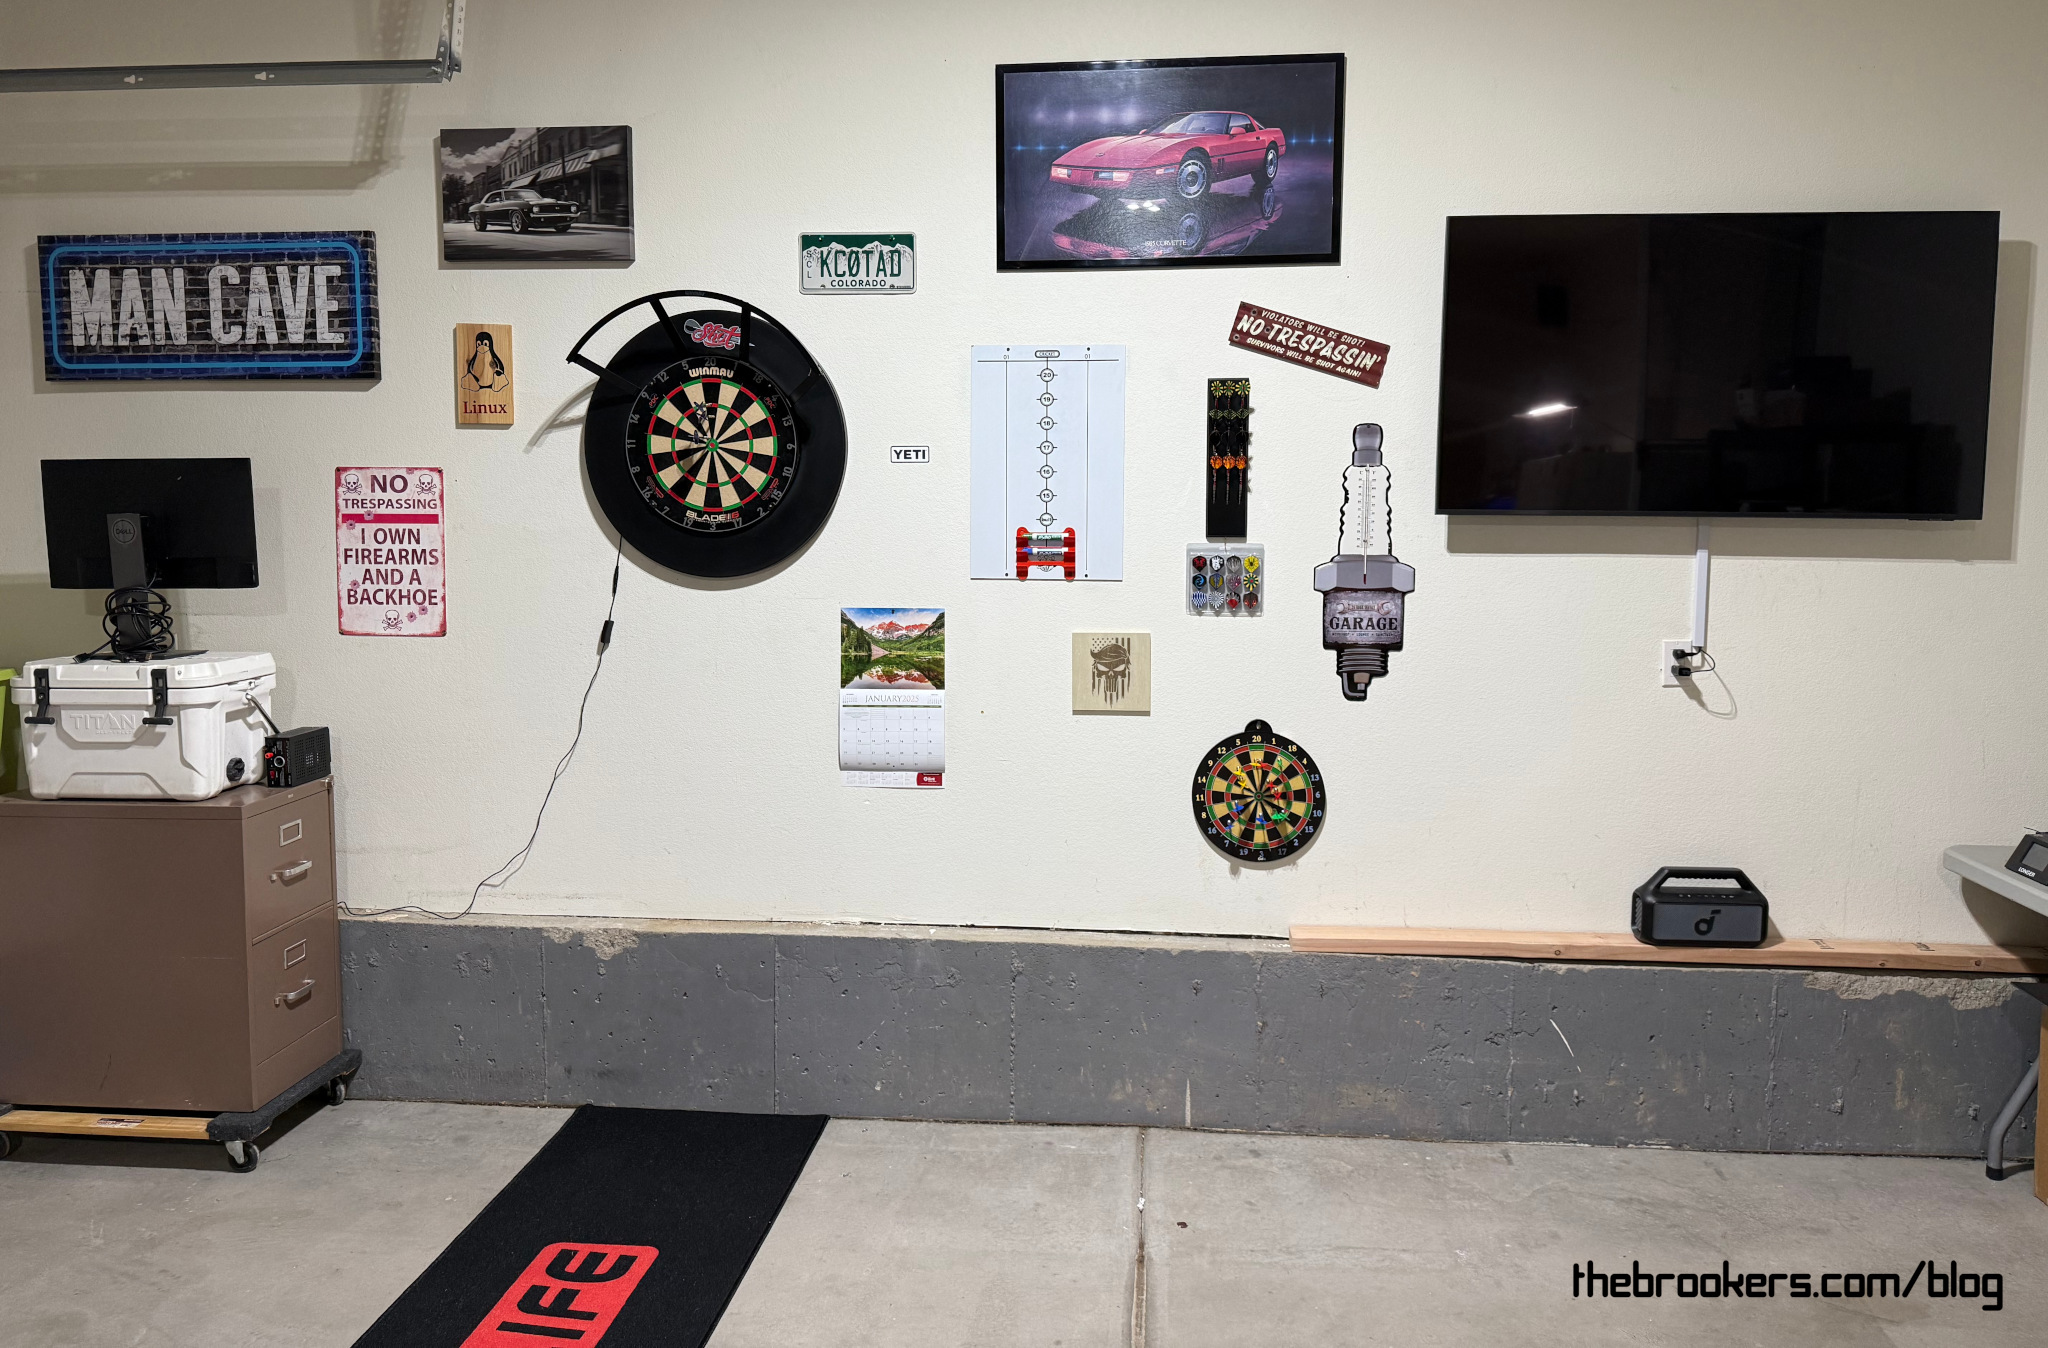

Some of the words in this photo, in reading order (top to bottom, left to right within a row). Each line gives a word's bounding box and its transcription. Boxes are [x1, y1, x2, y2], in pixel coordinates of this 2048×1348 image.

[830, 279, 886, 287] COLORADO
[69, 268, 189, 347] MAN
[207, 264, 345, 344] CAVE
[1236, 314, 1265, 336] NO
[1261, 310, 1305, 329] VIOLATORS
[1306, 323, 1325, 336] WILL
[1327, 329, 1338, 340] BE
[1340, 334, 1366, 348] SHOT!
[704, 357, 716, 366] 20
[1246, 337, 1286, 354] SURVIVORS
[1286, 349, 1302, 360] WILL
[1304, 355, 1314, 364] BE
[1315, 359, 1336, 370] SHOT
[1336, 365, 1362, 378] AGAIN!
[682, 360, 689, 370] 5
[657, 372, 670, 382] 12
[641, 391, 650, 400] 9
[462, 401, 508, 416] Linux
[630, 414, 640, 424] 14
[782, 416, 792, 427] 13
[627, 440, 636, 448] 11
[894, 450, 926, 460] YETI
[783, 466, 793, 478] 10
[370, 474, 408, 494] NO
[642, 486, 651, 498] 16
[771, 489, 782, 501] 15
[342, 498, 438, 511] TRESPASSING
[662, 506, 670, 514] 7
[757, 507, 765, 516] 2
[683, 518, 692, 528] 19
[710, 523, 716, 531] 3
[733, 517, 742, 528] 17
[361, 528, 366, 545] I
[373, 528, 421, 546] OWN
[344, 547, 439, 566] FIREARMS
[362, 568, 404, 586] AND
[408, 568, 422, 585] A
[347, 589, 438, 606] BACKHOE
[1330, 616, 1398, 630] GARAGE
[70, 712, 136, 730] TITAN
[2018, 866, 2036, 878] LONGER
[496, 1248, 637, 1348] IFE
